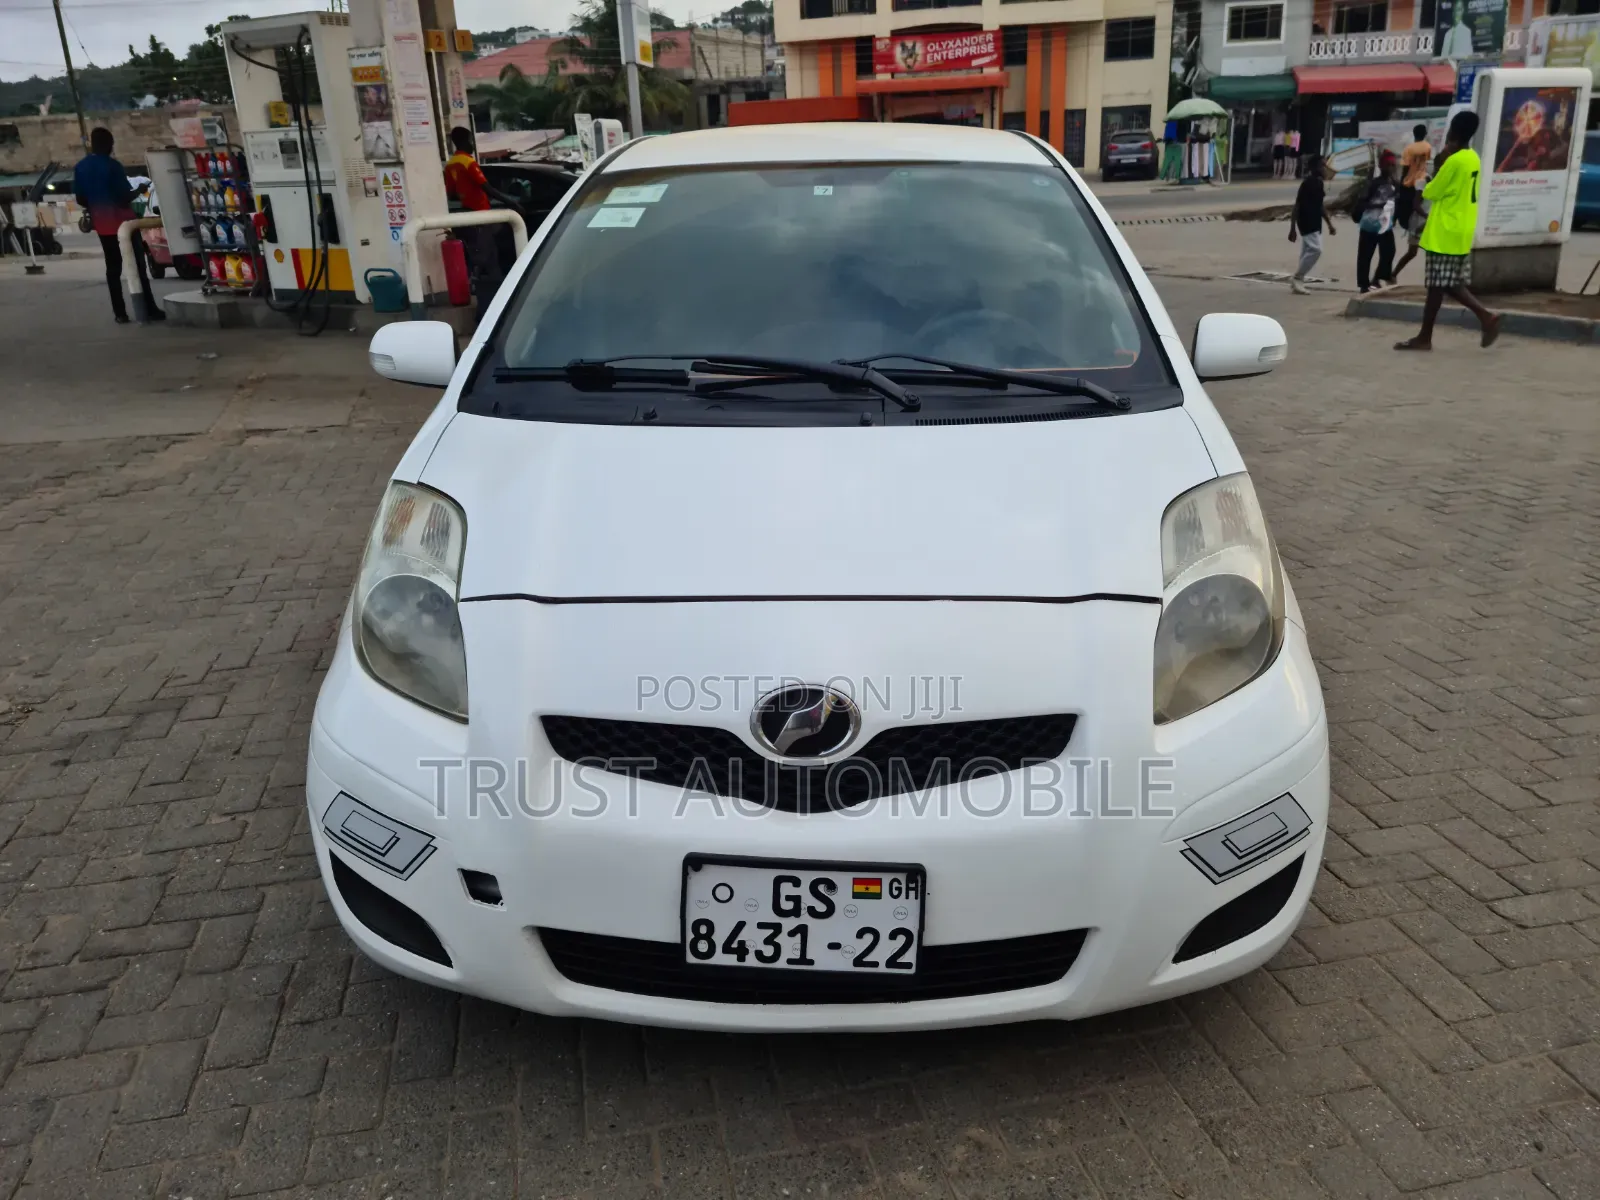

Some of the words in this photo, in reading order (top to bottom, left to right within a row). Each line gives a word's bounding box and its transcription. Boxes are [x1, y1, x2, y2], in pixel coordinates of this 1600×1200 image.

[435, 35, 443, 47] 2
[461, 35, 466, 46] 1
[927, 33, 993, 53] OLYXANDER
[926, 43, 995, 63] ENTERPRISE
[772, 875, 836, 919] GS
[888, 876, 919, 900] GH
[689, 917, 915, 970] 8431-22
